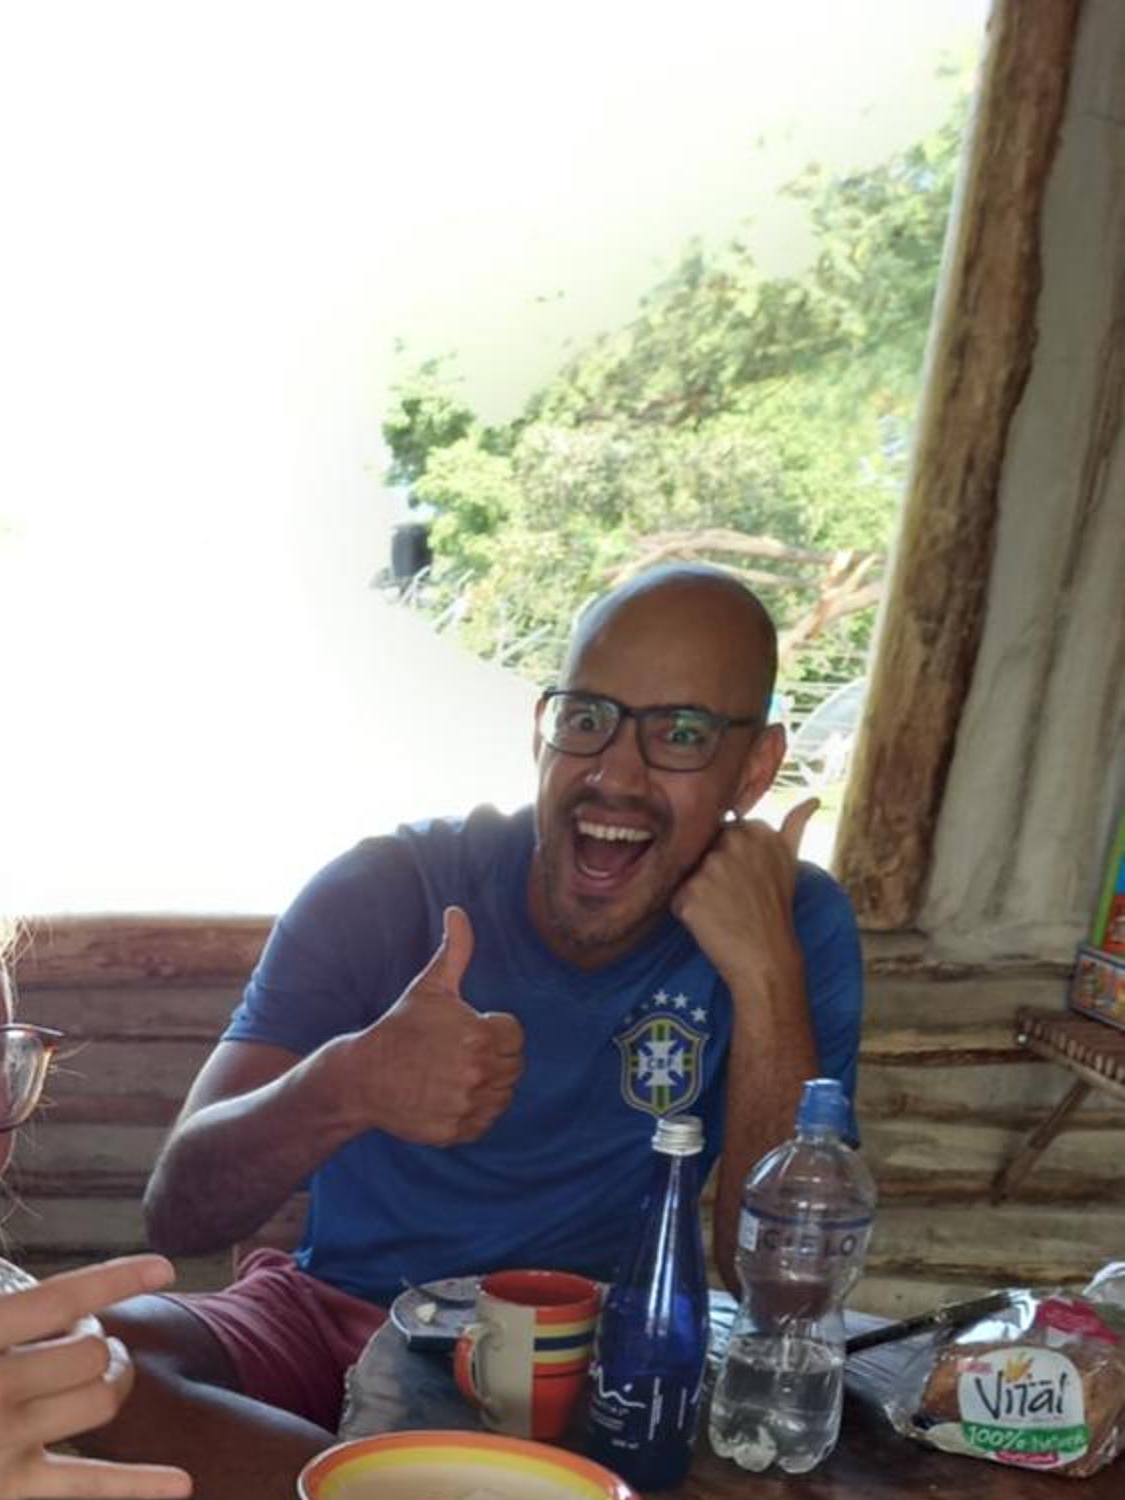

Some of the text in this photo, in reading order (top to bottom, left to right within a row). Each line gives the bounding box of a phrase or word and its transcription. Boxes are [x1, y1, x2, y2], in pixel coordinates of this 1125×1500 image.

[647, 1056, 676, 1071] CBF
[975, 1369, 1068, 1420] Vital
[969, 1425, 1025, 1449] 100%
